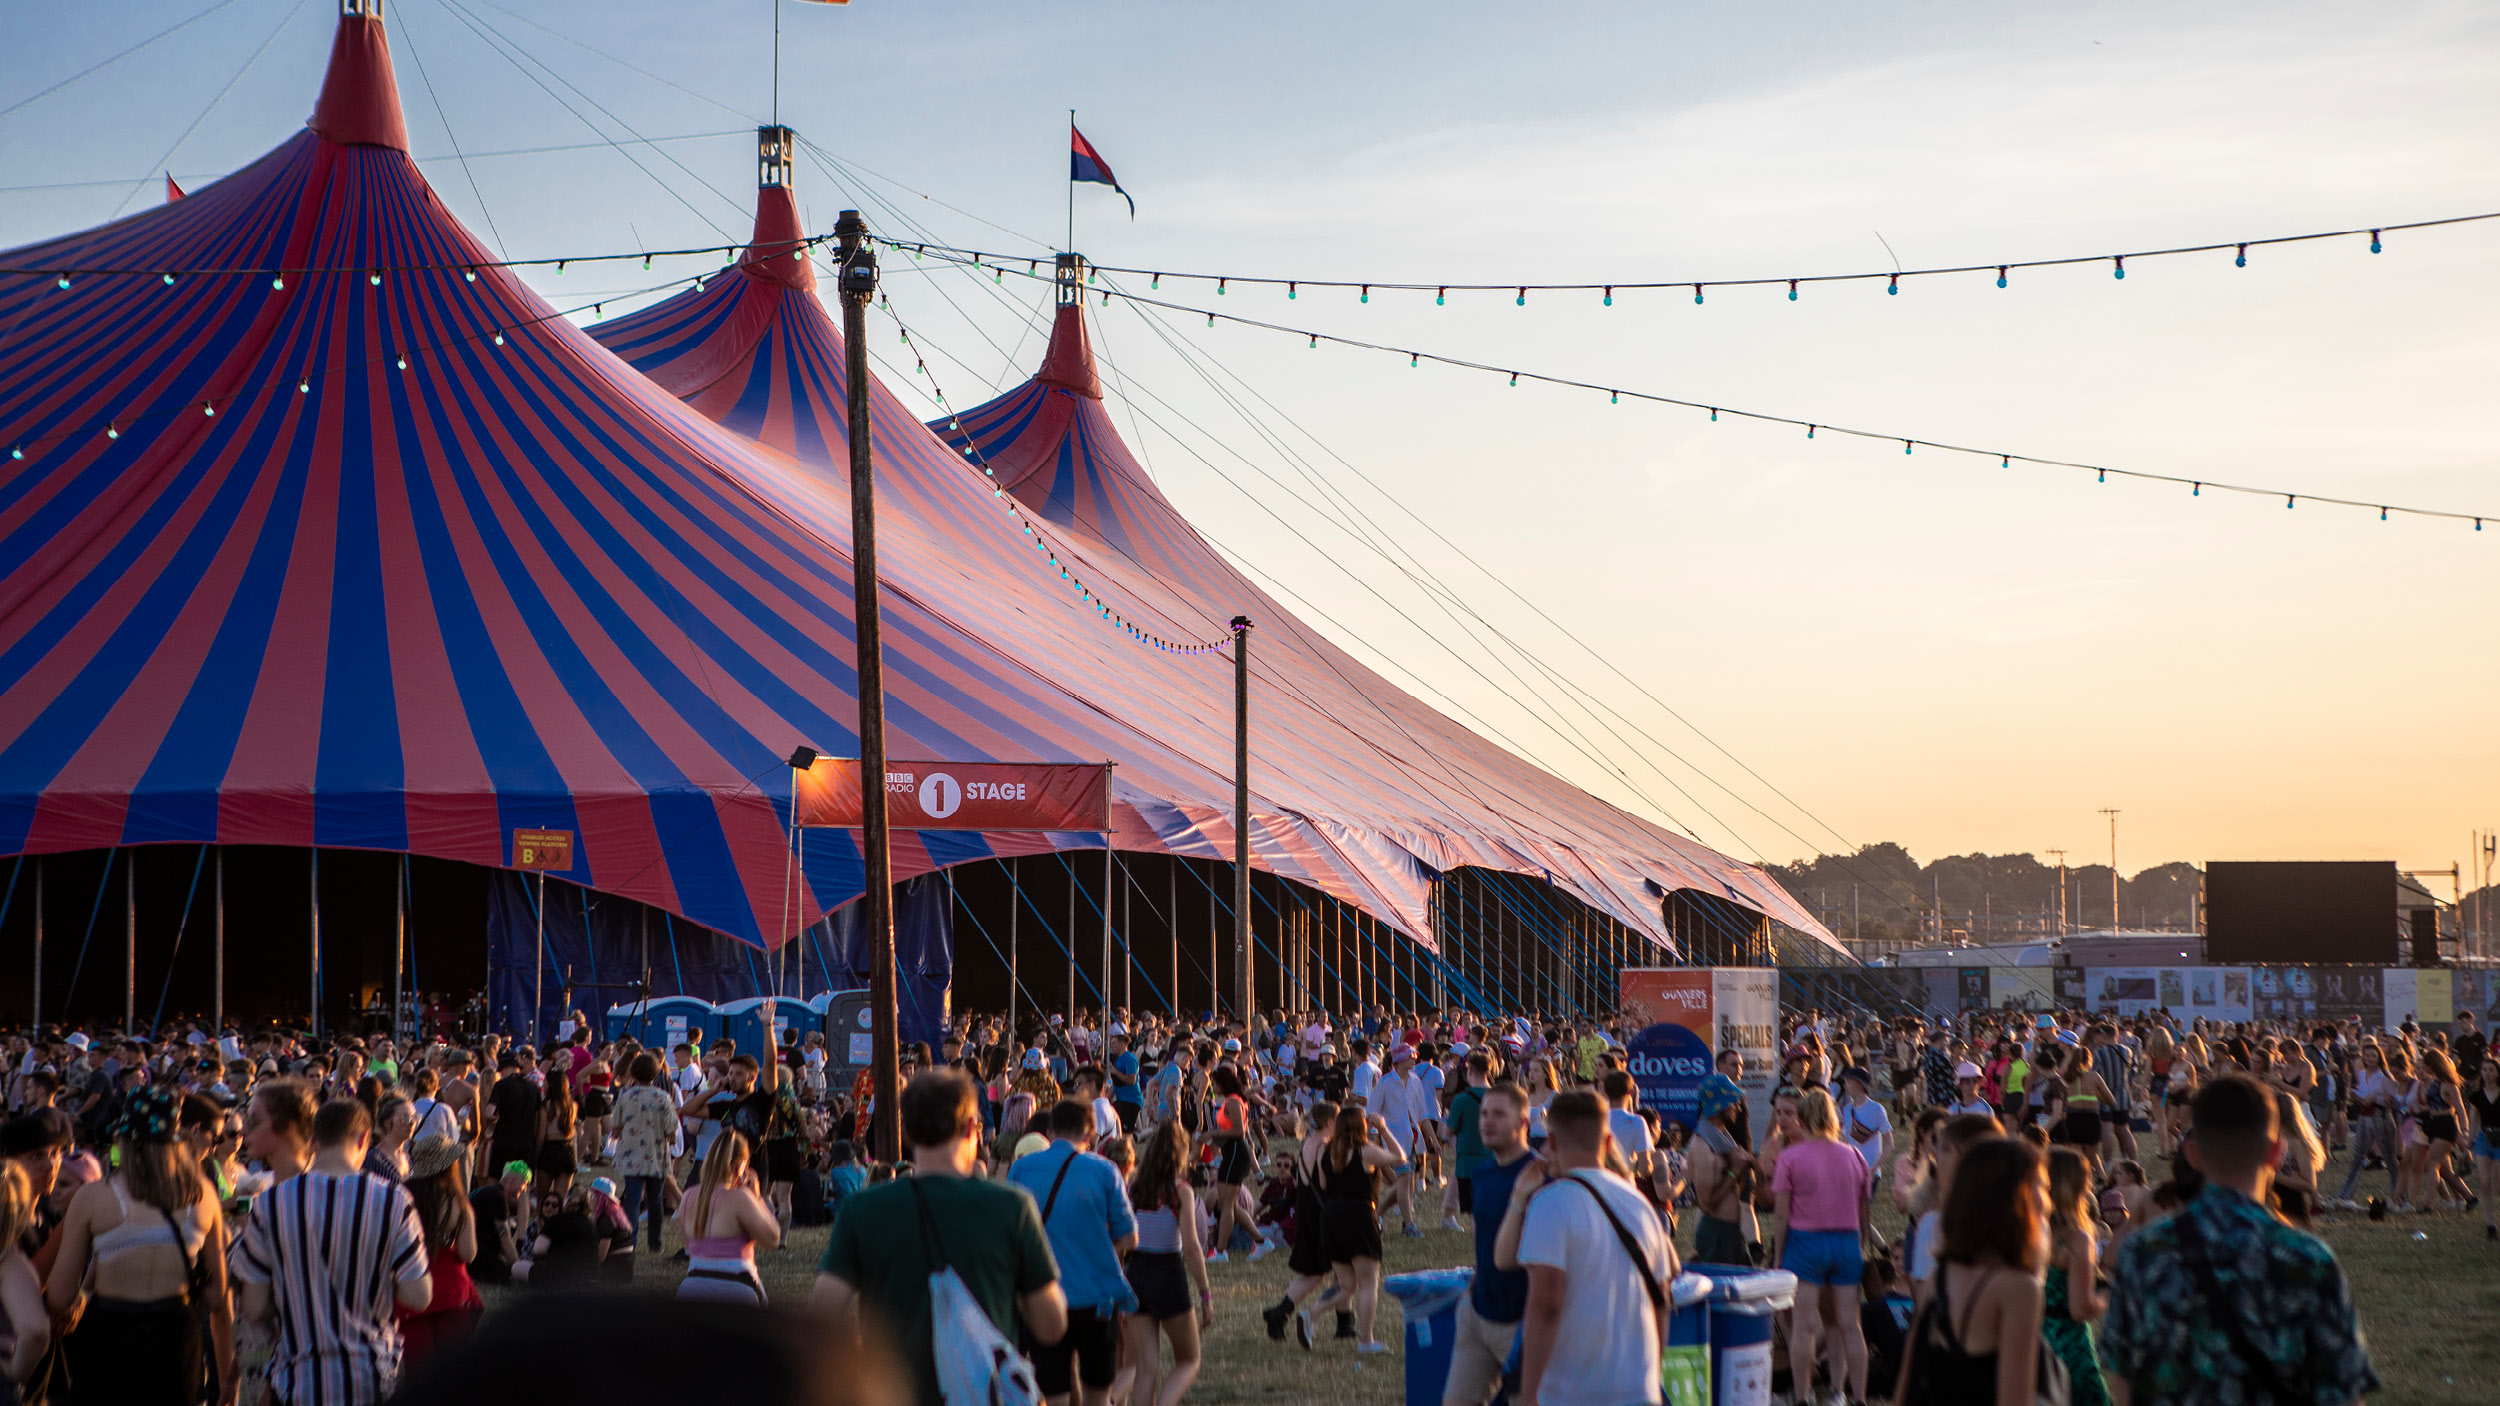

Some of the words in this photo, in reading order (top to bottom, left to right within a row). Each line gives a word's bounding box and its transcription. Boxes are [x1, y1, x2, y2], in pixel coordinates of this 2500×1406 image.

[886, 773, 914, 783] BBC
[934, 780, 945, 812] 1
[966, 783, 1025, 800] STAGE
[523, 848, 534, 864] B
[1721, 1025, 1773, 1049] SPECIALS
[1629, 1051, 1706, 1076] doves
